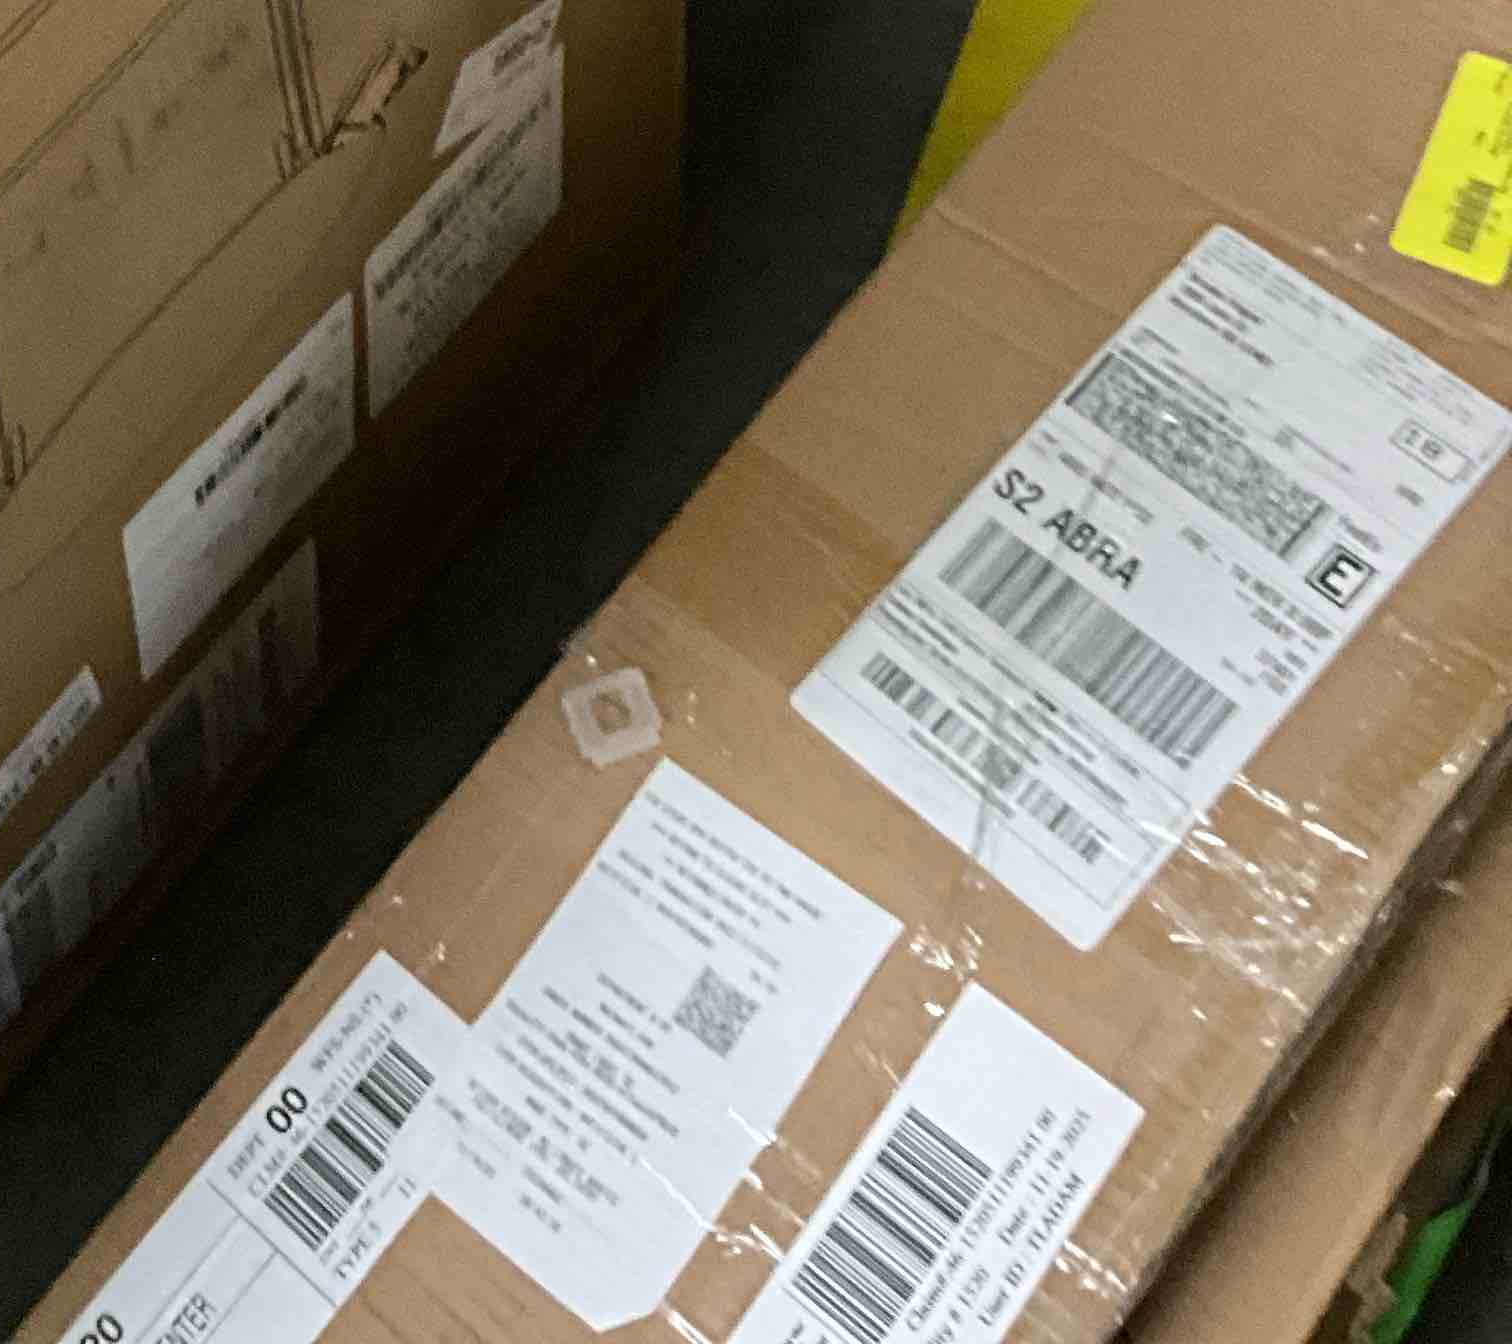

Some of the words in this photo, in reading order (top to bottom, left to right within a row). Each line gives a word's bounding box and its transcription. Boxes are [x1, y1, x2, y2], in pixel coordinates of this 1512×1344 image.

[991, 467, 1046, 515] S2
[1041, 508, 1145, 593] ABRA
[1318, 552, 1365, 598] E
[265, 1086, 309, 1134] 00
